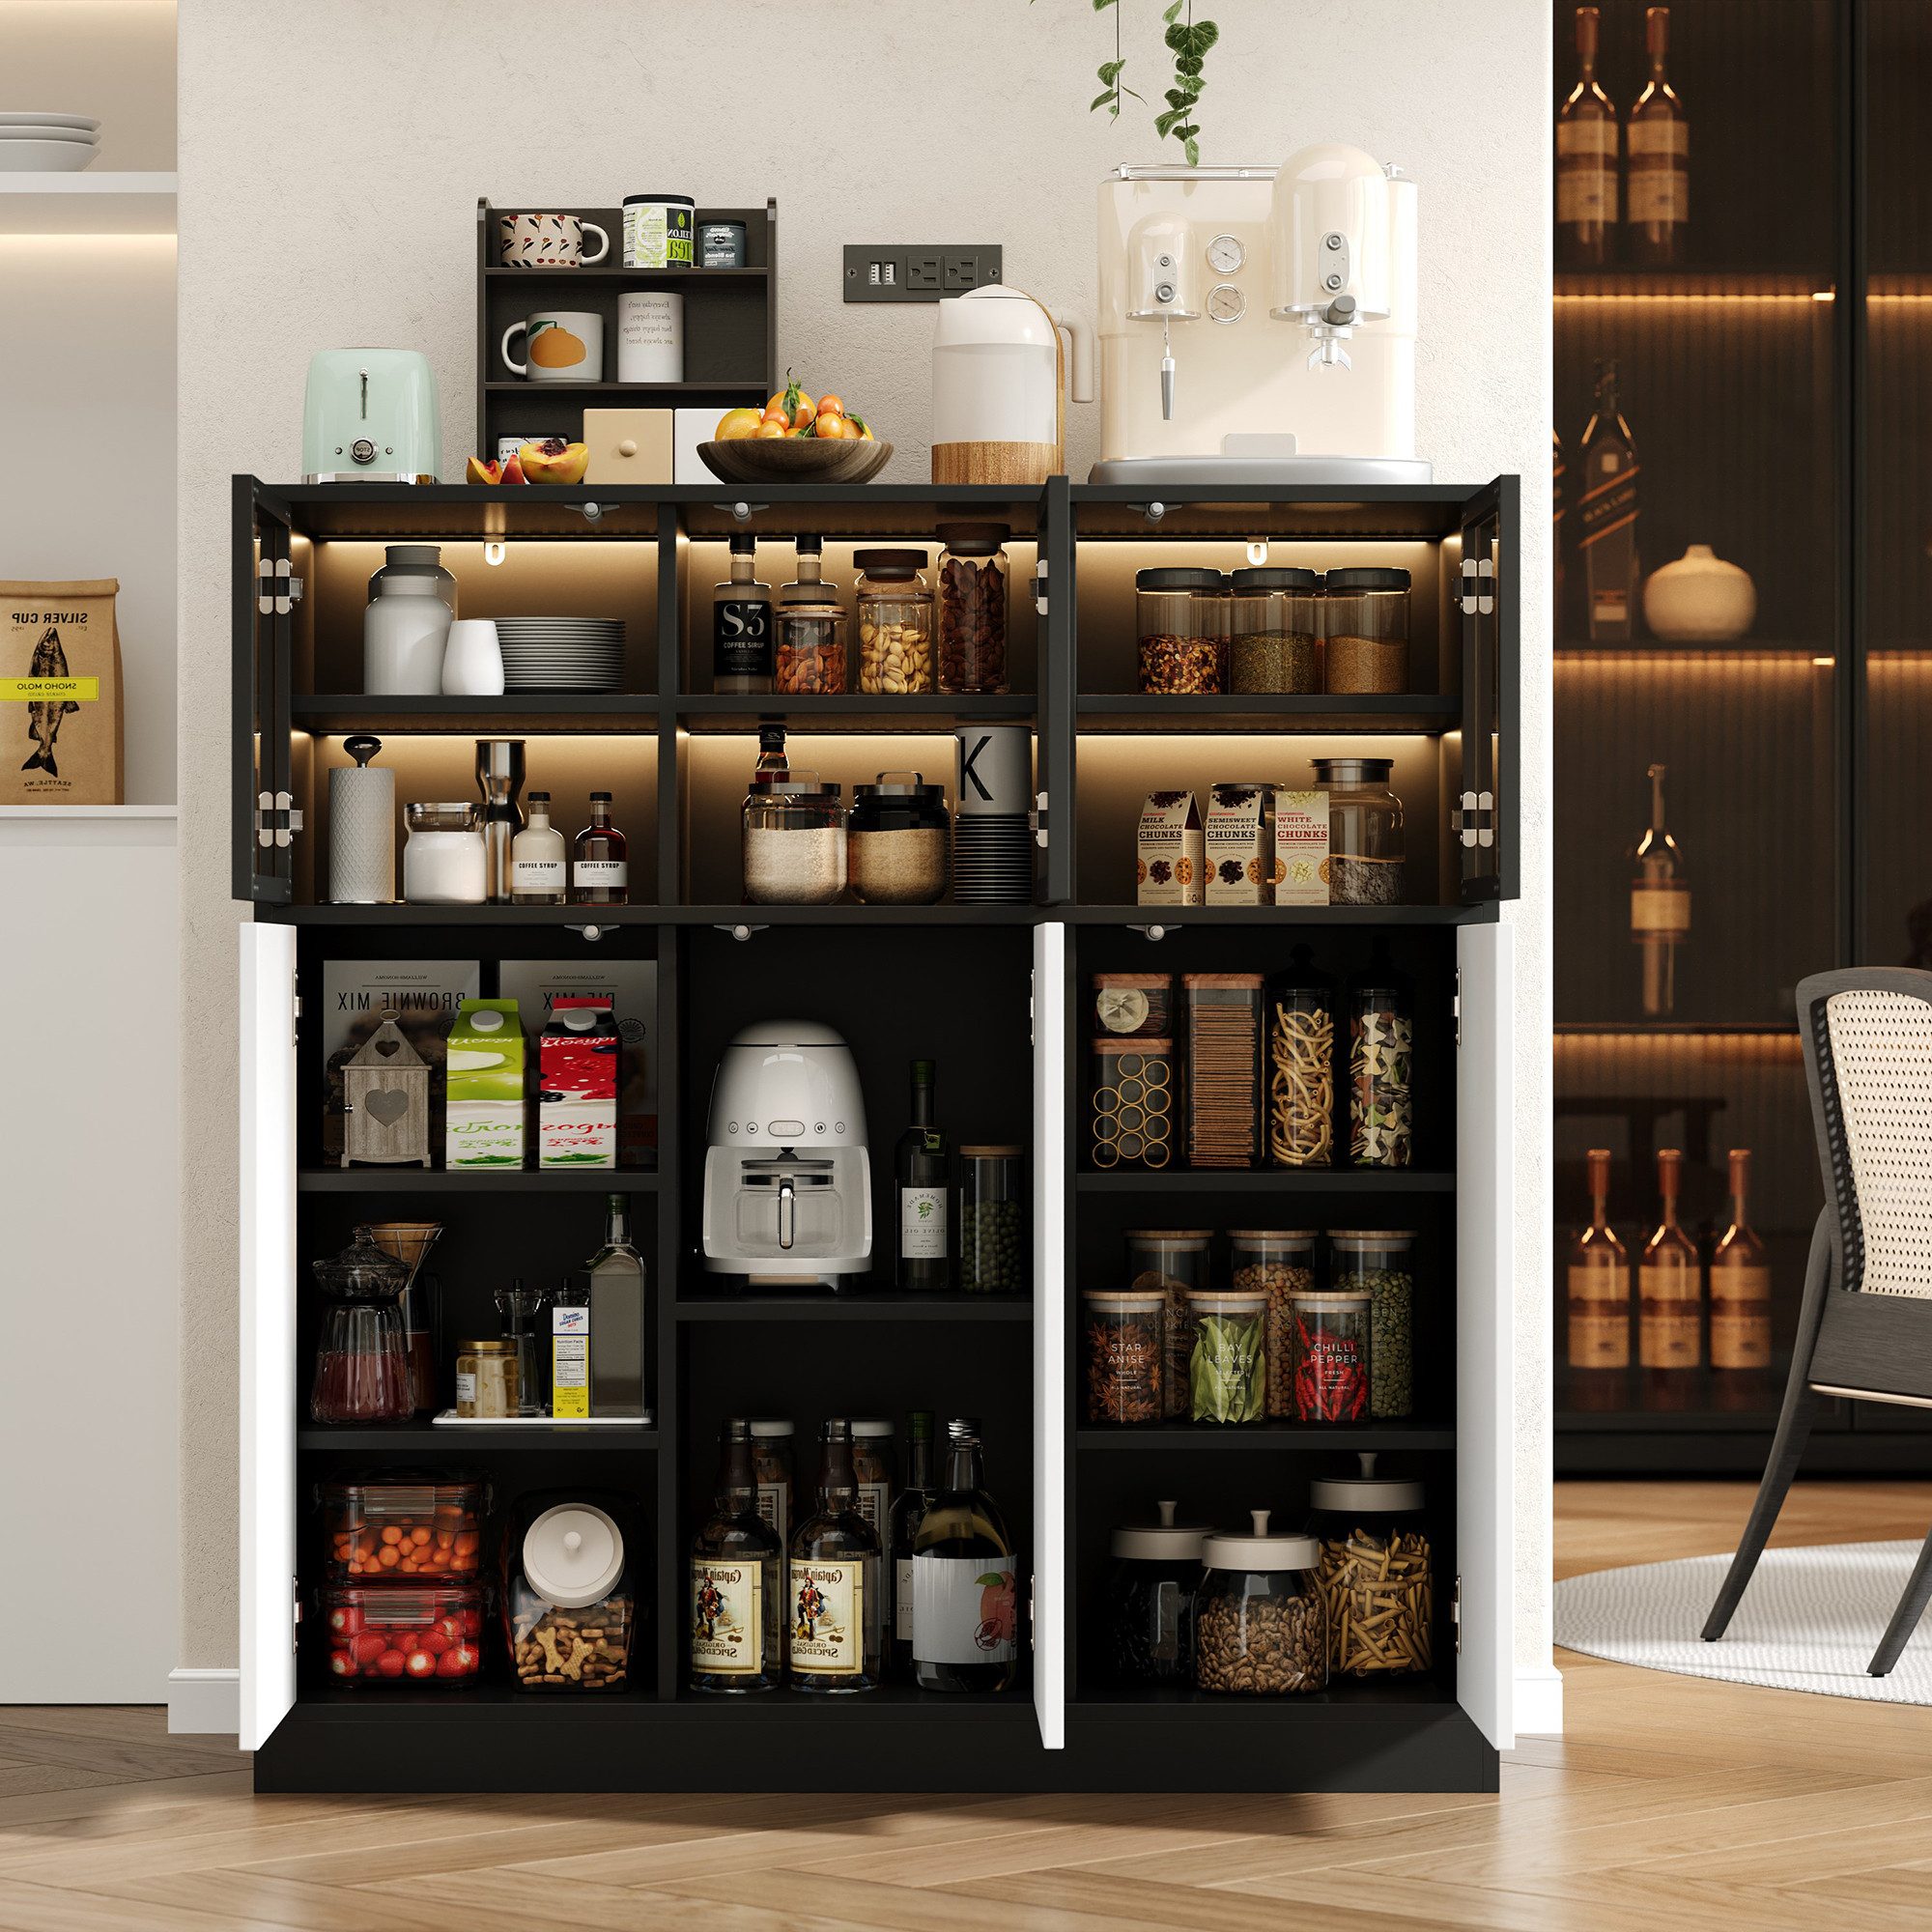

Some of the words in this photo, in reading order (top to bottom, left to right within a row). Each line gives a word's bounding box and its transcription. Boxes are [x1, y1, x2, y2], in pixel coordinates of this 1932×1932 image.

[721, 603, 765, 638] S3
[959, 735, 995, 802] K
[1111, 1343, 1142, 1352] STAR
[1219, 1343, 1242, 1352] BAY
[1314, 1343, 1354, 1352] CHILLI
[1108, 1354, 1145, 1364] ANISE
[1208, 1354, 1253, 1364] LEAVES
[1310, 1354, 1358, 1364] PEPPER
